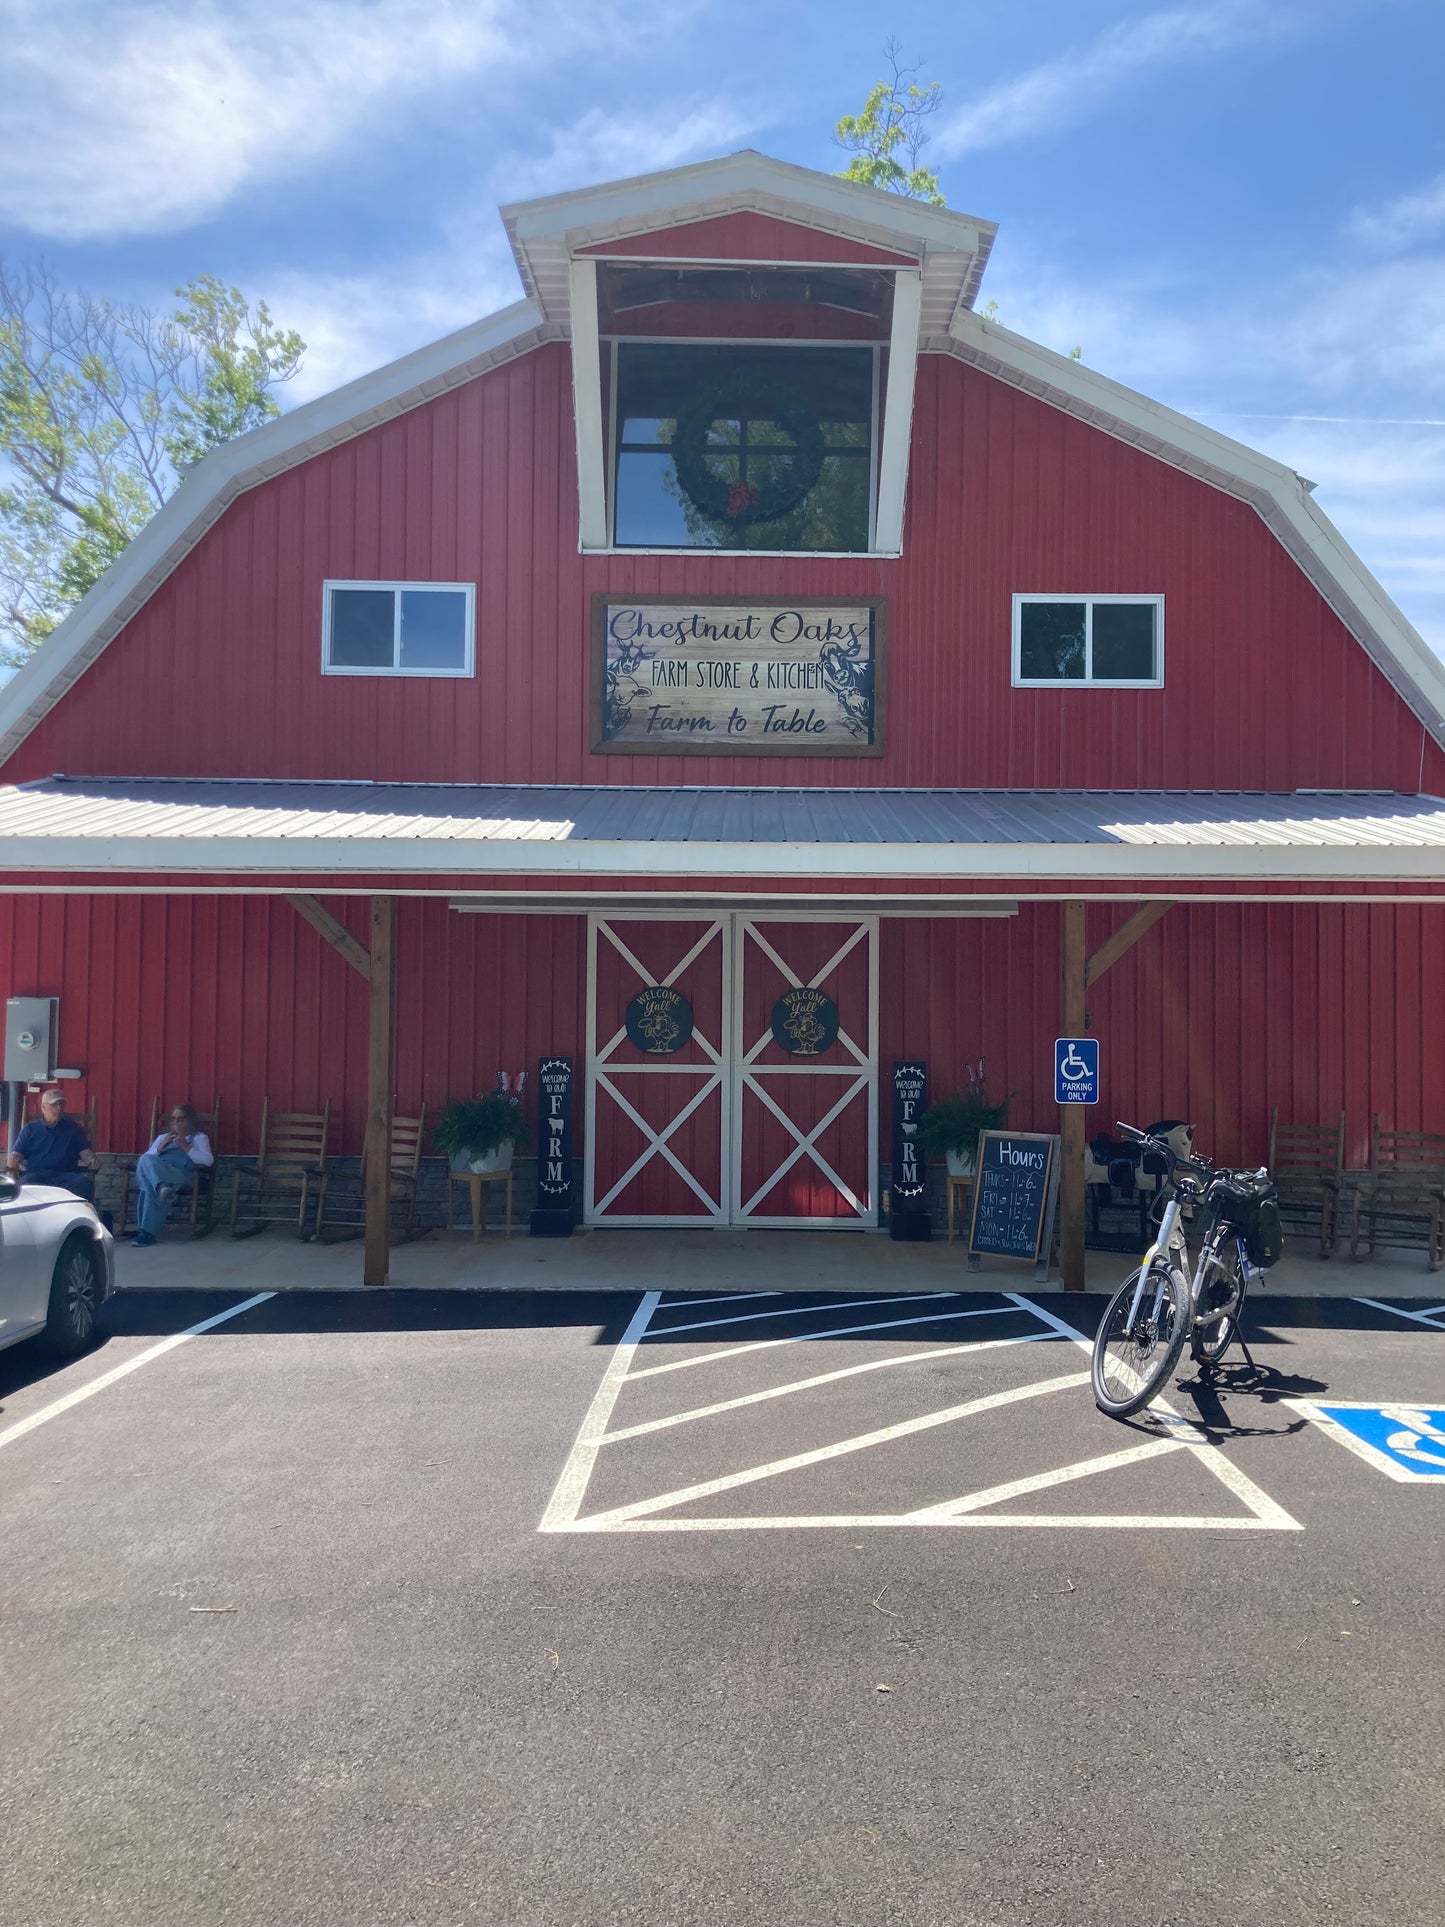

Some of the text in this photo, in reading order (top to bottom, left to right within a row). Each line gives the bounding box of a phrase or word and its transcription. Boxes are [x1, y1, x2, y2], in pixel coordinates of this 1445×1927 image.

[609, 610, 867, 646] Chestnut Oaks
[652, 660, 825, 689] FARM STORE & KITCHEN
[646, 703, 828, 734] Farm to Table
[636, 990, 681, 1005] WELCOME
[782, 991, 827, 1006] WELCOME
[1062, 1082, 1093, 1091] PARKING
[1067, 1091, 1087, 1101] ONLY
[999, 1141, 1044, 1170] Hours
[983, 1191, 998, 1205] FRI
